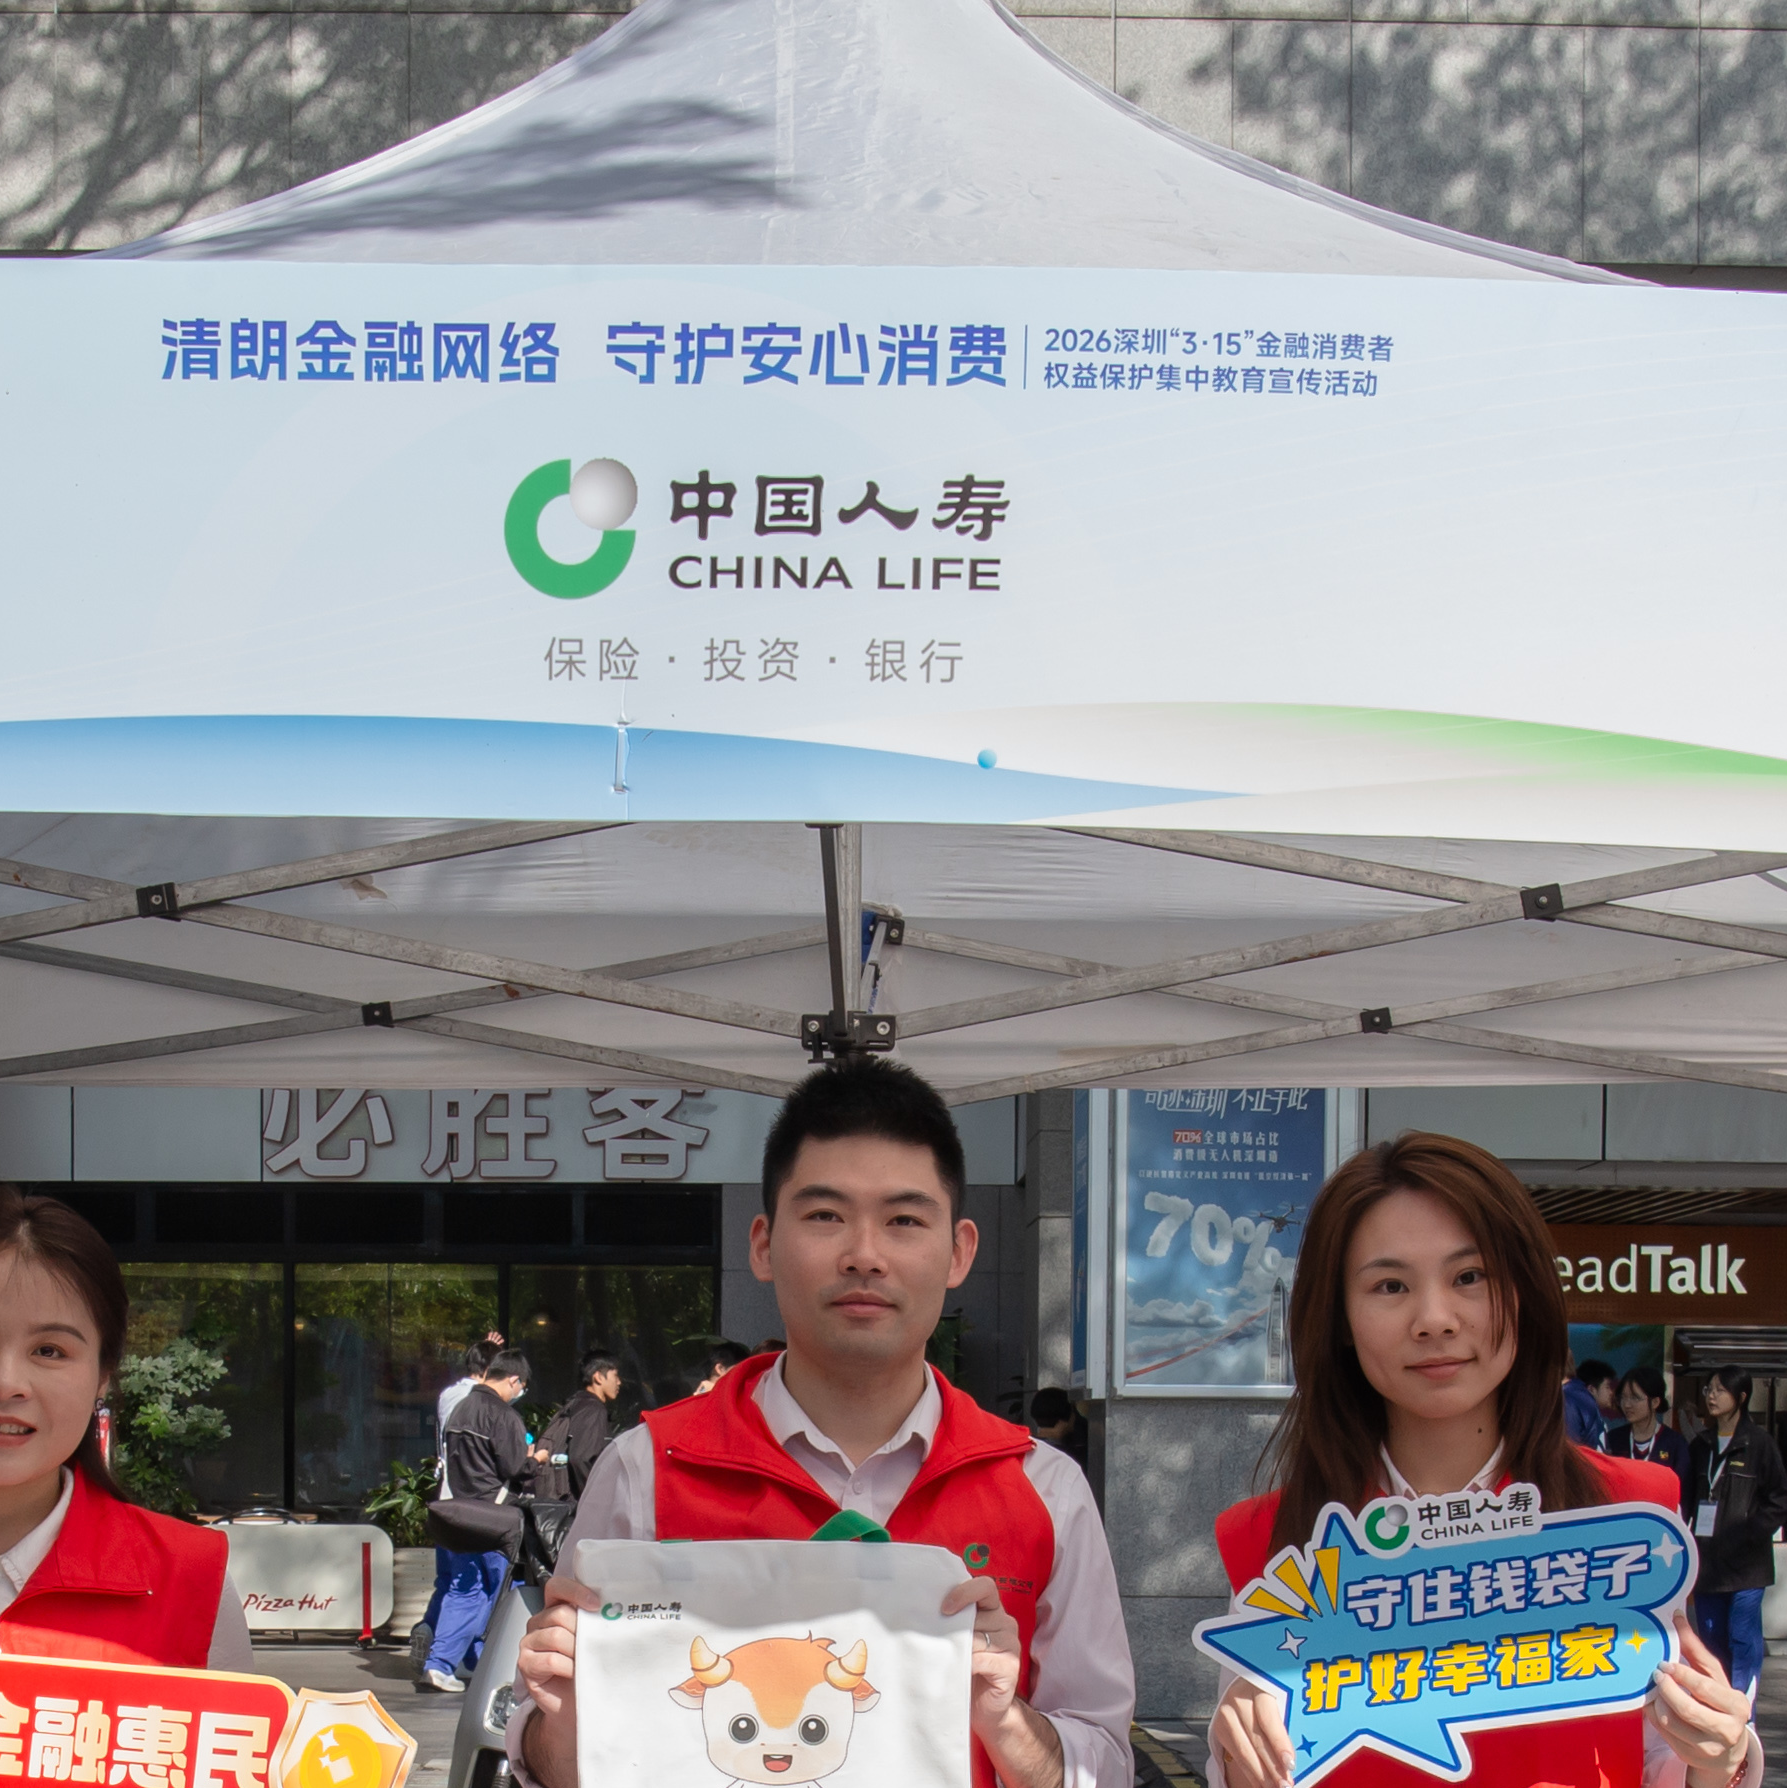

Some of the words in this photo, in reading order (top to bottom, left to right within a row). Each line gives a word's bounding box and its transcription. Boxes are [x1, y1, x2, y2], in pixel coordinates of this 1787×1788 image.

[161, 318, 561, 386] 清朗金融网络
[605, 320, 1009, 390] 守护安心消费
[1043, 361, 1378, 398] 权益保护集中教育宣传活动
[669, 471, 1011, 543] 中国人寿
[669, 553, 851, 594] CHINA
[879, 556, 1001, 595] LIFE
[262, 1088, 710, 1180] 必胜客
[1144, 1190, 1283, 1273] 70%
[1554, 1243, 1748, 1296] eadTalk
[1418, 1490, 1534, 1526] 中国人寿
[1420, 1519, 1487, 1542] CHINA
[1490, 1514, 1534, 1534] LIFE
[243, 1593, 295, 1612] Pizza
[297, 1593, 338, 1611] Hut
[627, 1601, 683, 1614] 中国人寿
[1346, 1542, 1650, 1630] 守住钱袋子
[627, 1612, 656, 1620] CHINA
[660, 1612, 682, 1620] LIFE
[1303, 1625, 1617, 1714] 护好幸福家
